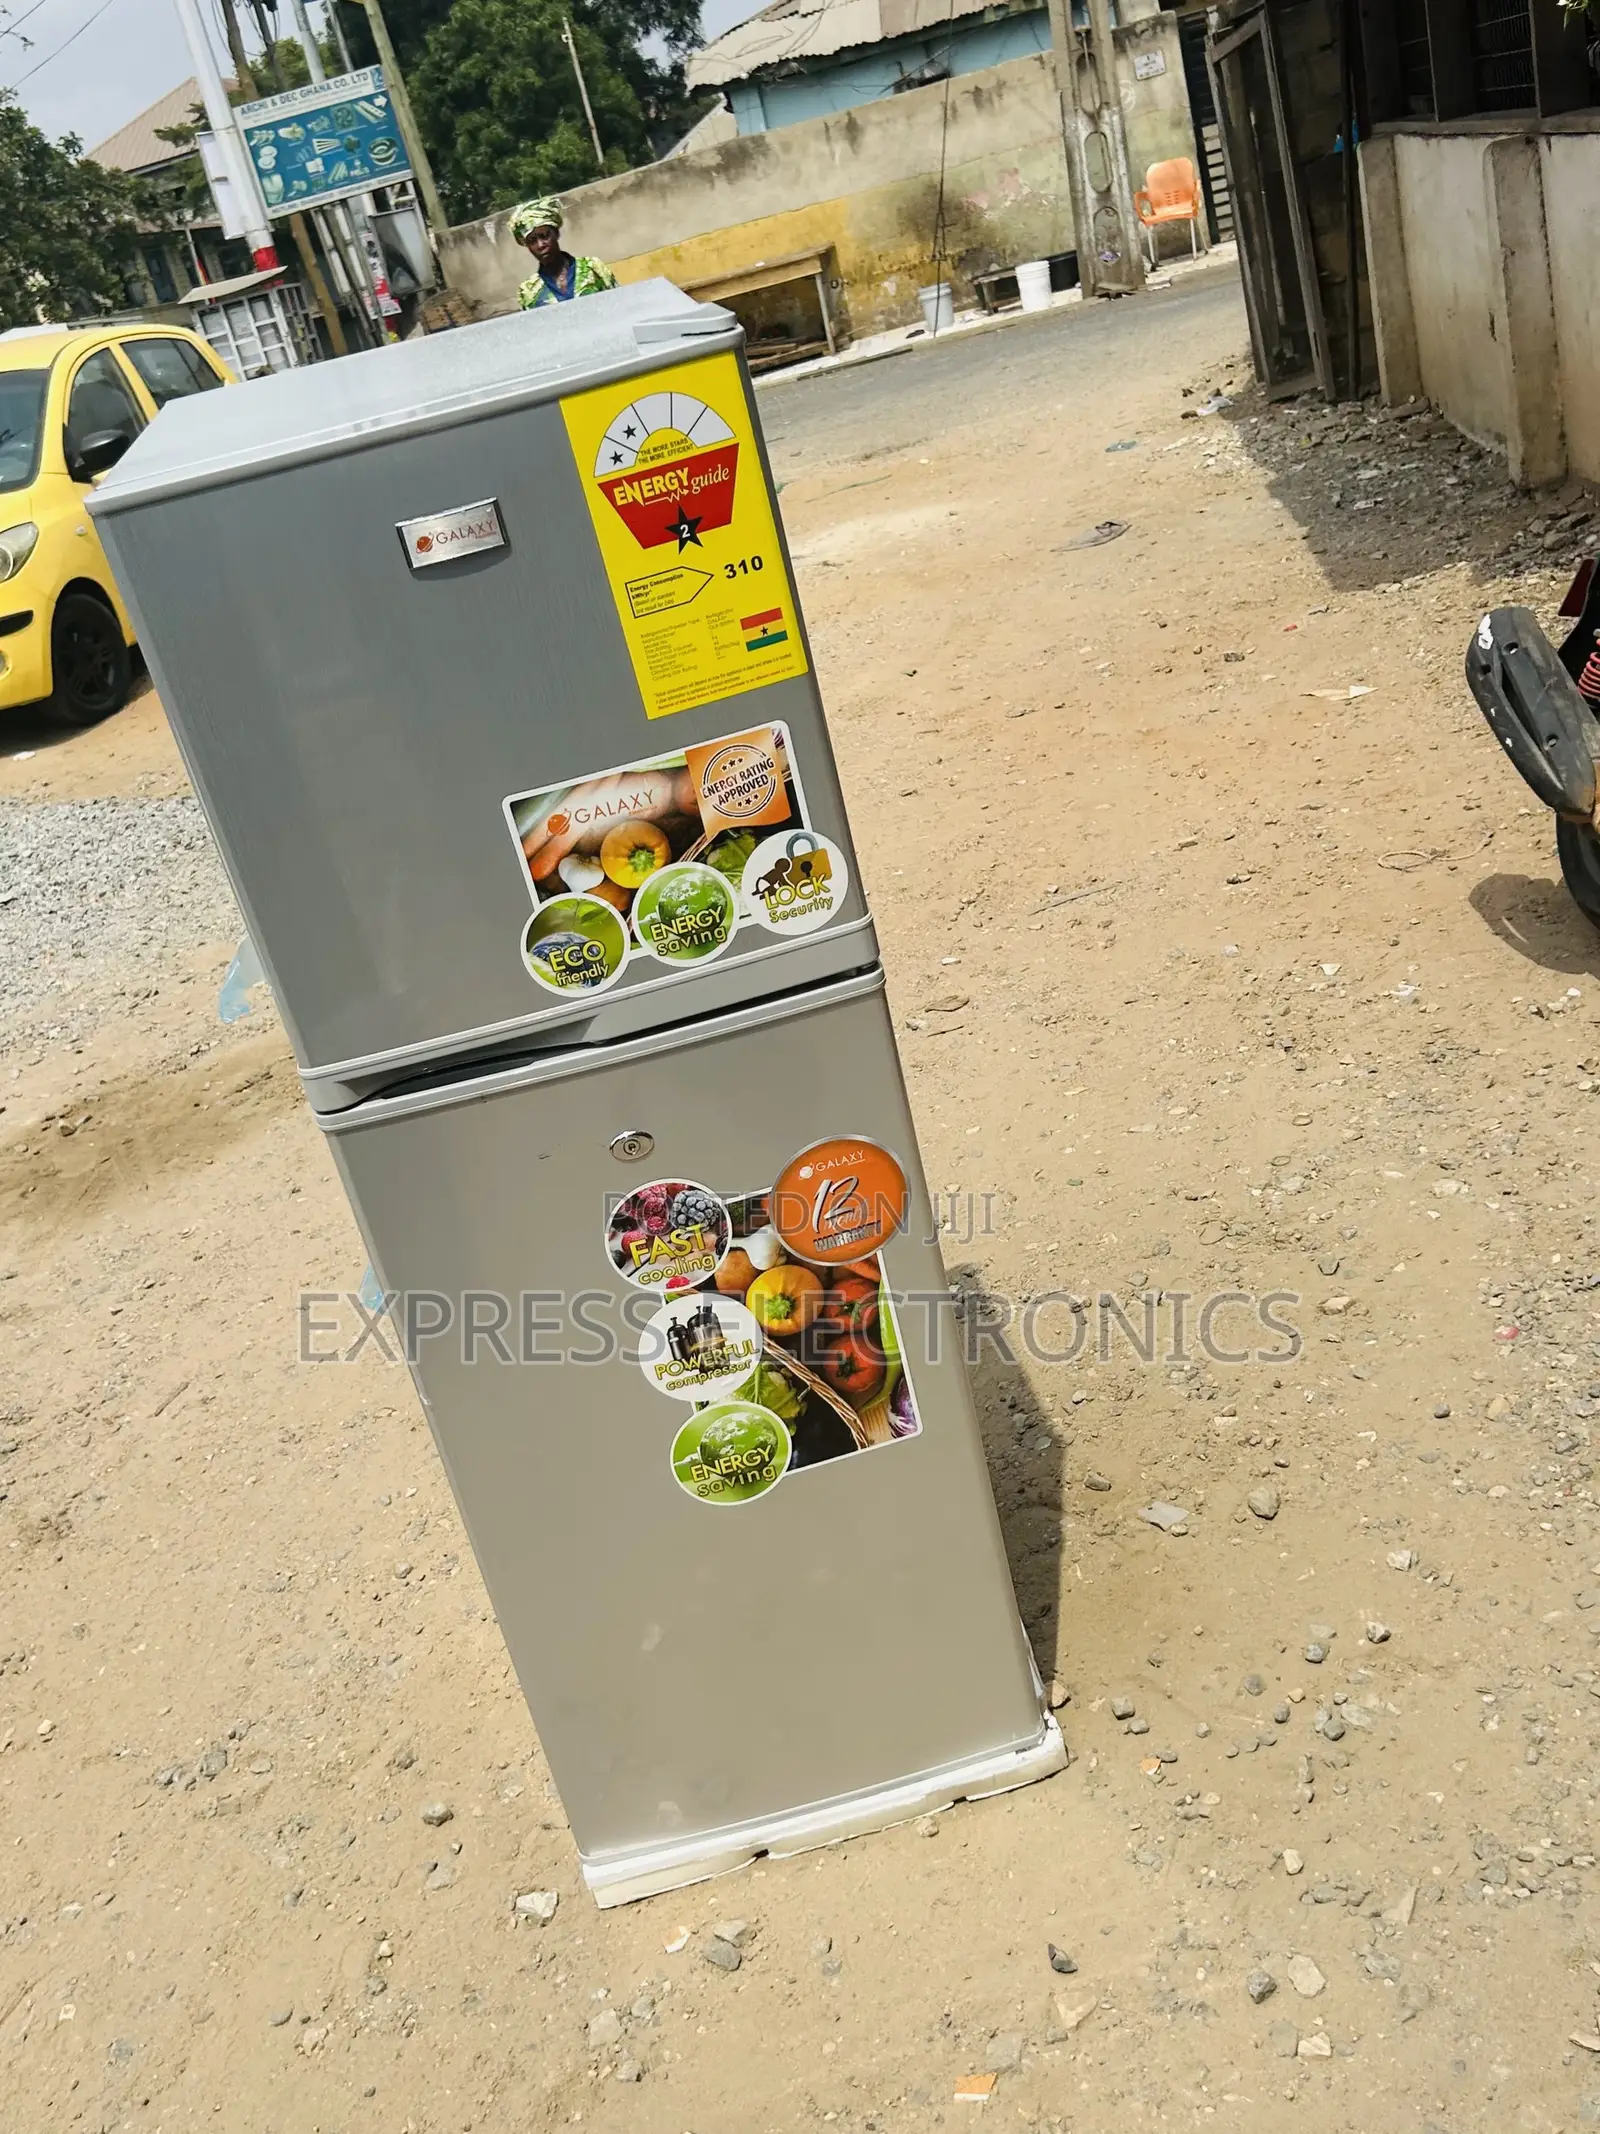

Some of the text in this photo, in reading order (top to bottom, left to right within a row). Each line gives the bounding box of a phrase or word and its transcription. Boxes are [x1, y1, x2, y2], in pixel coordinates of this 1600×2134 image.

[271, 98, 277, 108] &
[300, 84, 332, 99] GHANA
[333, 79, 350, 90] CO.
[351, 72, 369, 85] LTD
[638, 443, 694, 464] THE MORE EFFICIENT
[641, 437, 689, 456] THE MORE STARS
[613, 463, 730, 507] ENERGY guide
[436, 520, 494, 545] GALAXY
[680, 524, 691, 539] 2
[723, 555, 764, 579] 310
[702, 757, 775, 799] ENERGY RATING
[717, 773, 769, 806] APPROVED
[574, 789, 654, 824] GALAXY
[764, 873, 831, 911] LOCK
[650, 906, 724, 942] ENERGY
[769, 895, 834, 924] Security
[549, 939, 606, 971] ECO
[657, 926, 727, 956] saving
[555, 962, 610, 987] friendly
[815, 1149, 864, 1172] GALAXY
[812, 1176, 860, 1235] 12
[629, 1222, 706, 1269] FAST
[638, 1254, 716, 1285] cooling
[653, 1338, 761, 1381] POWERFUL
[665, 1359, 753, 1391] compressor
[690, 1445, 773, 1484] ENERGY
[696, 1464, 778, 1497] saving
